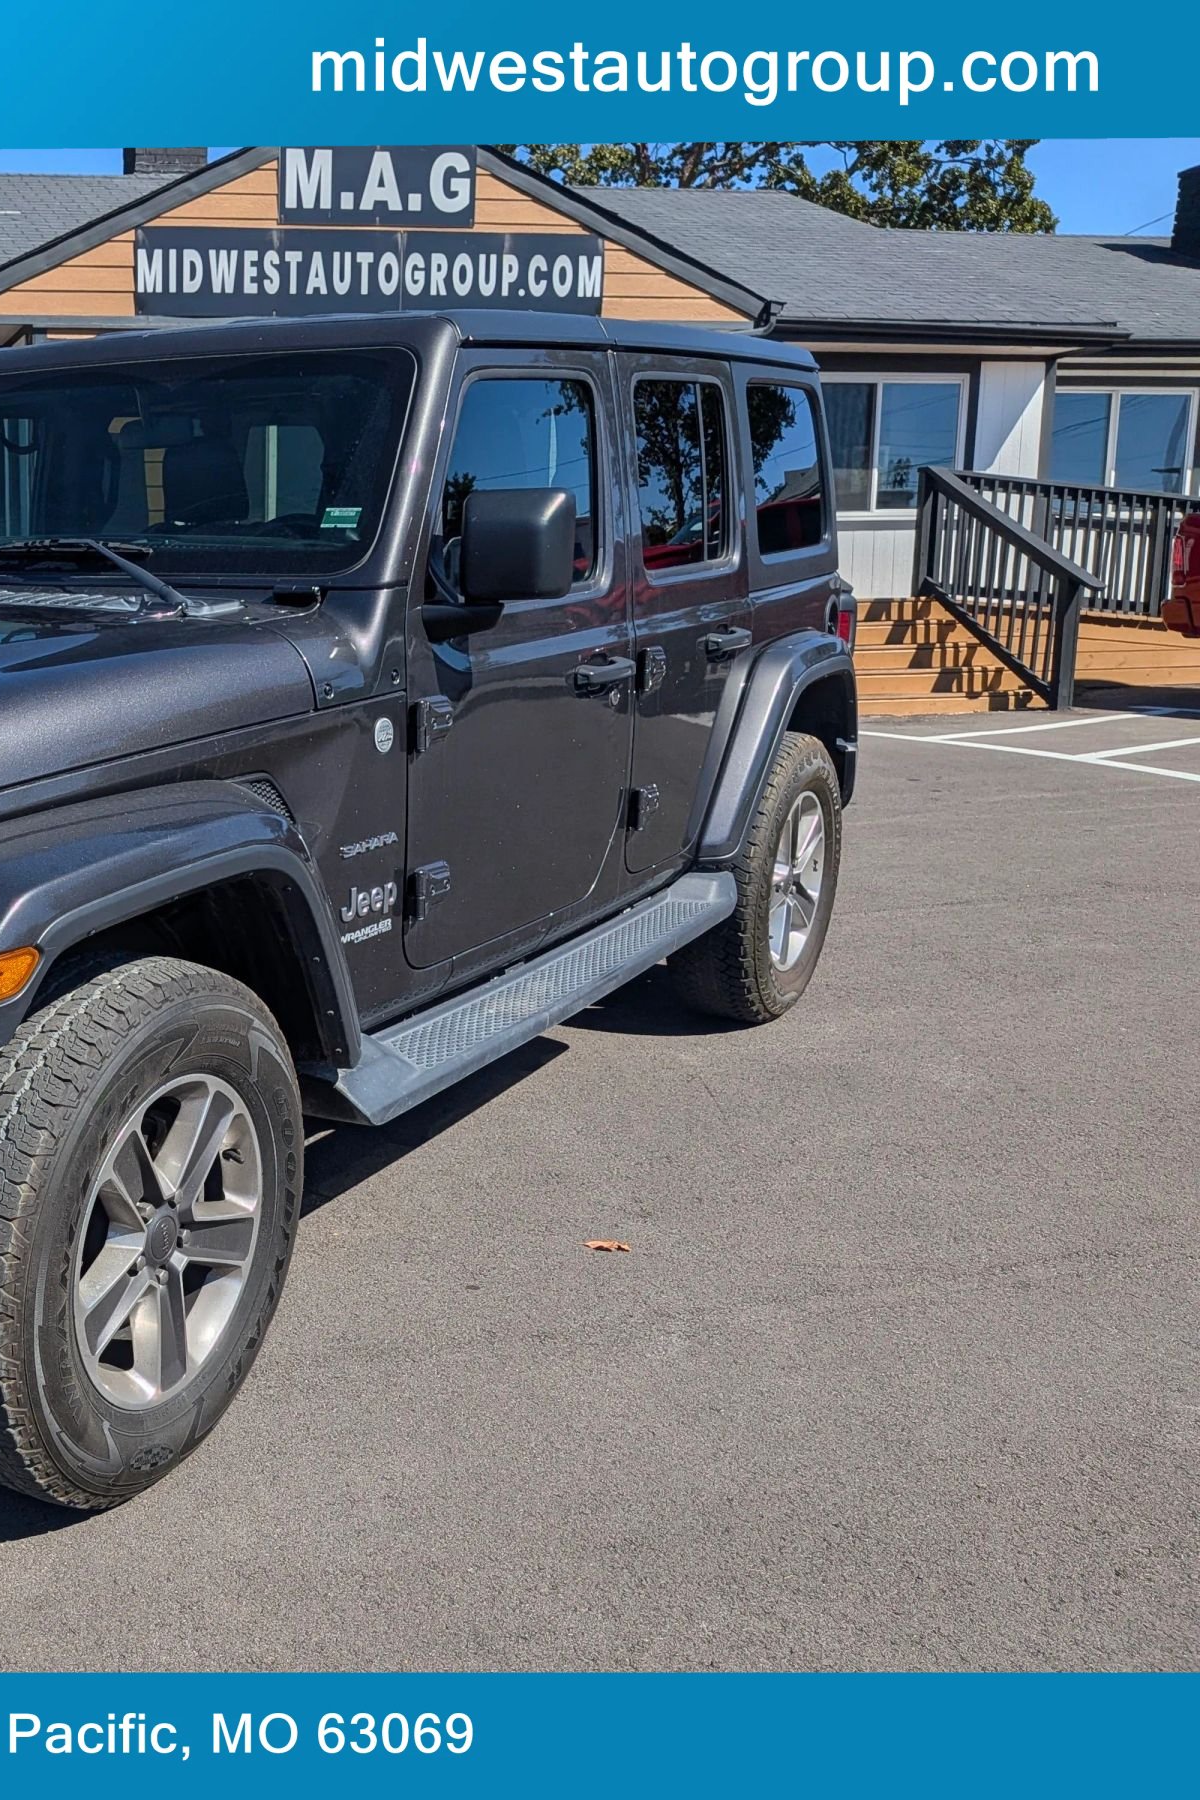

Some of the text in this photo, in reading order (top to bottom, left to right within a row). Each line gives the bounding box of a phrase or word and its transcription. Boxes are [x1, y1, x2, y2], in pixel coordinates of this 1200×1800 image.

[285, 148, 471, 213] M.A.G
[137, 249, 603, 298] MIDWESTAUTOGROUP.COM
[340, 832, 398, 859] SAHARA
[341, 881, 398, 922] Jeep
[341, 918, 392, 944] WRANGLER
[225, 1087, 298, 1394] GOODYEAR
